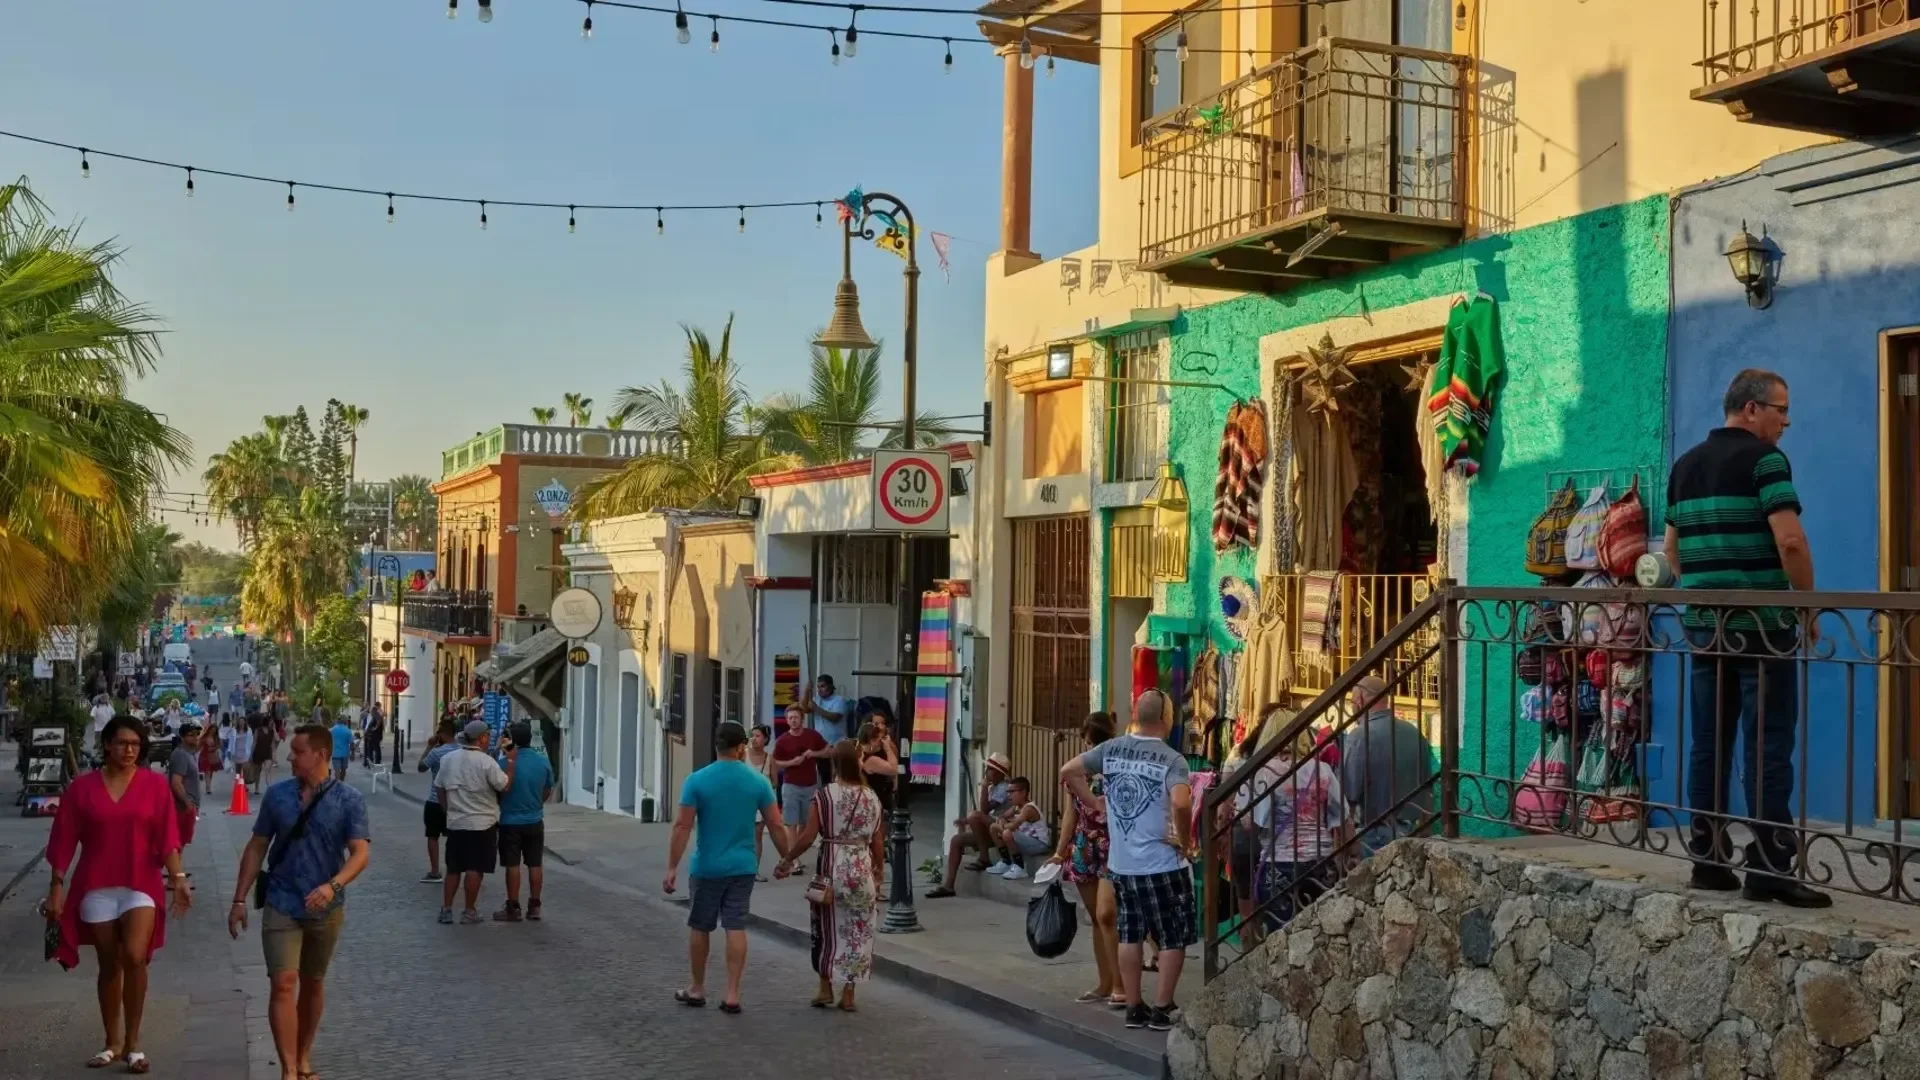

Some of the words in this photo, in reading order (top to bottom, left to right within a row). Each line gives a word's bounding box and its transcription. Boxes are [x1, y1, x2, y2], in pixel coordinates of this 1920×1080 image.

[897, 468, 927, 494] 30
[894, 496, 928, 508] Km/h
[387, 676, 408, 687] ALTO
